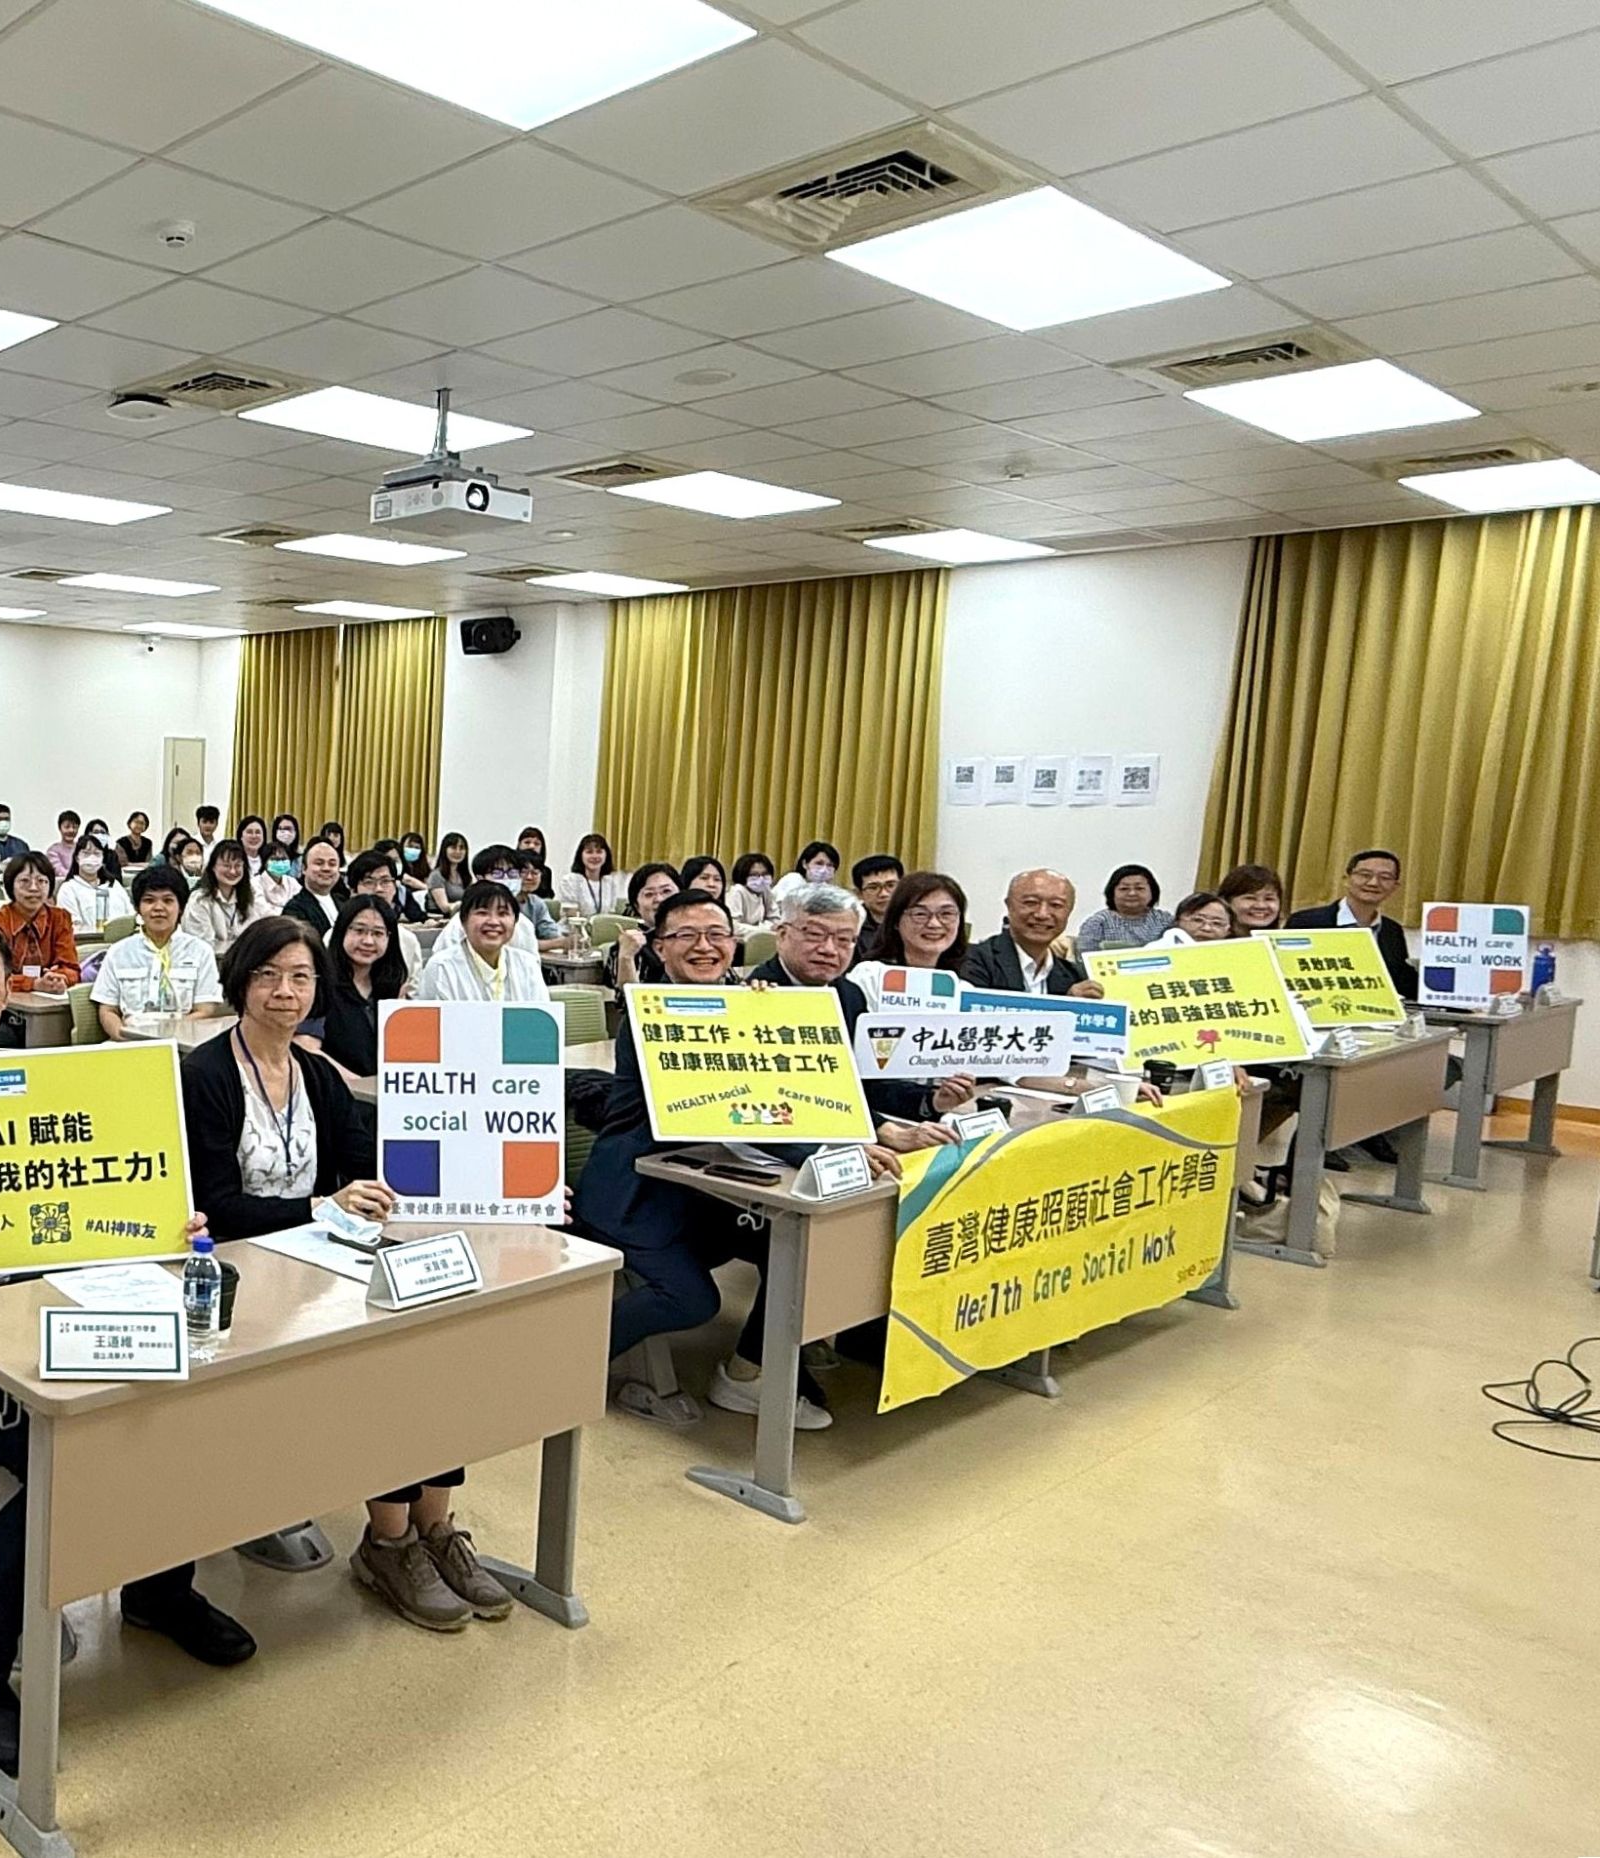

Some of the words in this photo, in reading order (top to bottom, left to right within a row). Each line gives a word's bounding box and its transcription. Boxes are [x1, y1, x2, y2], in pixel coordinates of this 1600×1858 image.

[1424, 935, 1477, 948] HEALTH
[1485, 940, 1515, 949] care
[1435, 953, 1472, 964] social
[1481, 955, 1522, 967] WORK
[1147, 977, 1234, 1000] 自我管理
[881, 995, 921, 1008] HEALTH
[925, 1001, 947, 1010] care
[911, 1026, 1054, 1053] 中山醫學大學
[658, 1051, 840, 1073] 健康照顧社會工作
[909, 1055, 940, 1068] Chung
[941, 1055, 965, 1066] Shan
[967, 1054, 1004, 1066] Medical
[1005, 1054, 1050, 1067] University
[384, 1071, 476, 1095] HEALTH
[492, 1078, 540, 1095] care
[666, 1093, 717, 1113] #HEALTH
[718, 1084, 752, 1101] social
[814, 1096, 853, 1114] WORK
[29, 1112, 94, 1146] 賦能
[402, 1110, 468, 1132] social
[485, 1111, 558, 1134] WORK
[391, 1202, 557, 1217] 臺灣健康照顧社會工作學會
[921, 1149, 1219, 1278] 臺灣健康照顧社會工作學會
[86, 1219, 157, 1239] #AI神隊友
[1033, 1264, 1071, 1302] Care
[1081, 1237, 1135, 1286] Social
[94, 1335, 133, 1348] 王道維
